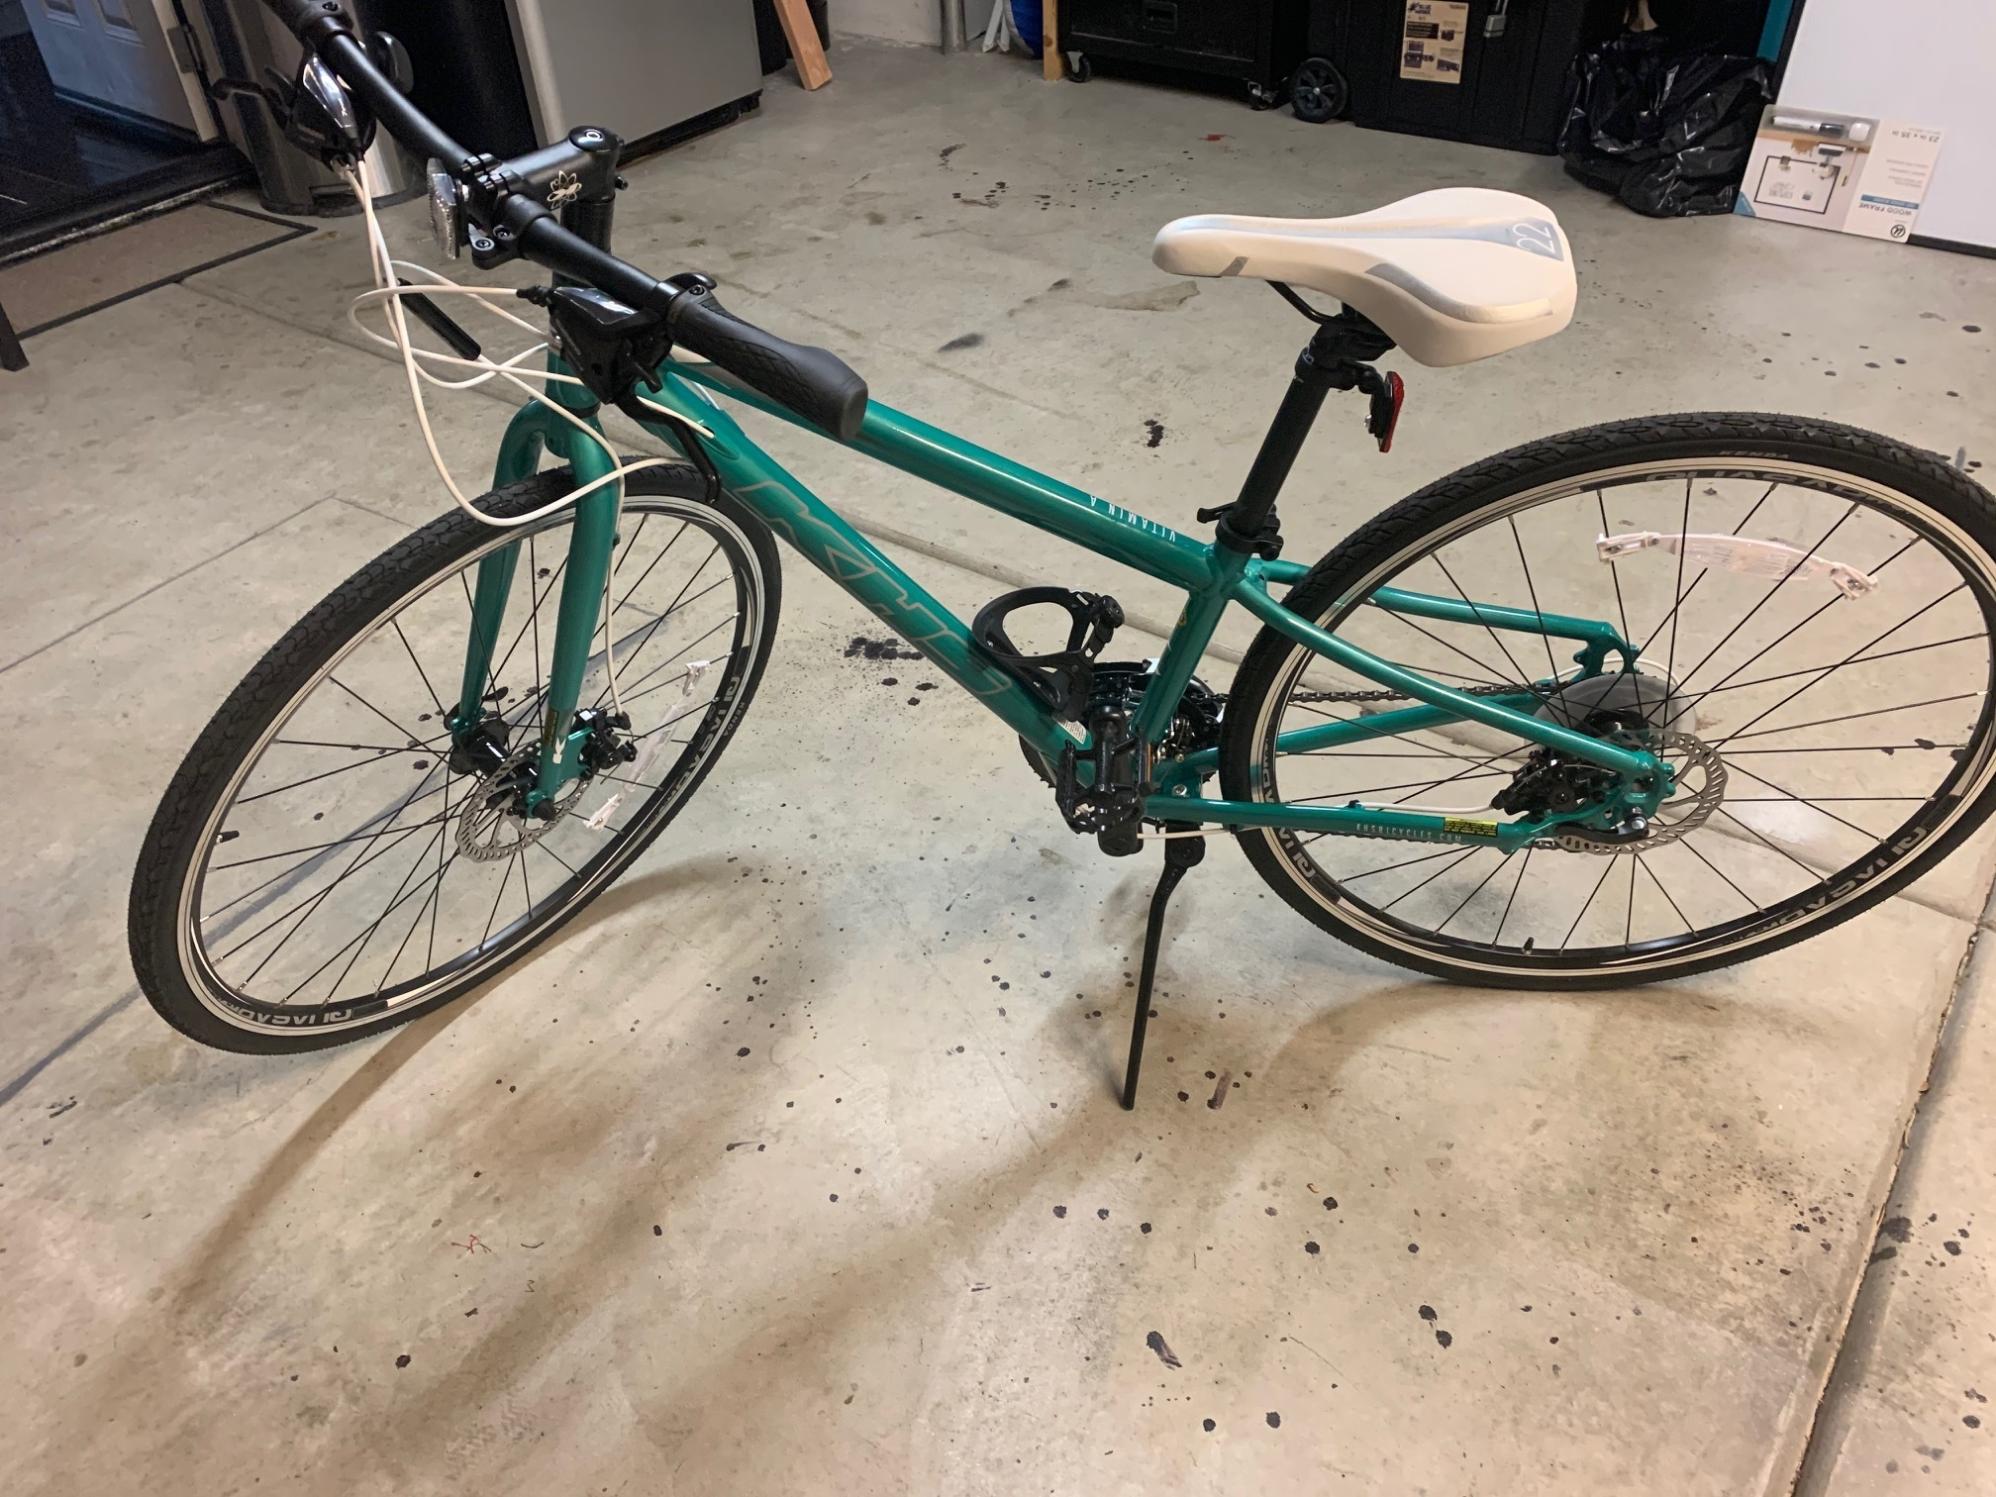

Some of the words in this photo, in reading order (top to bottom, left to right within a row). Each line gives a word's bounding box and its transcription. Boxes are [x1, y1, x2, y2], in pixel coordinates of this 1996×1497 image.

[1089, 495, 1097, 507] A
[1108, 503, 1176, 542] VITAMIN
[732, 480, 1013, 695] KHS
